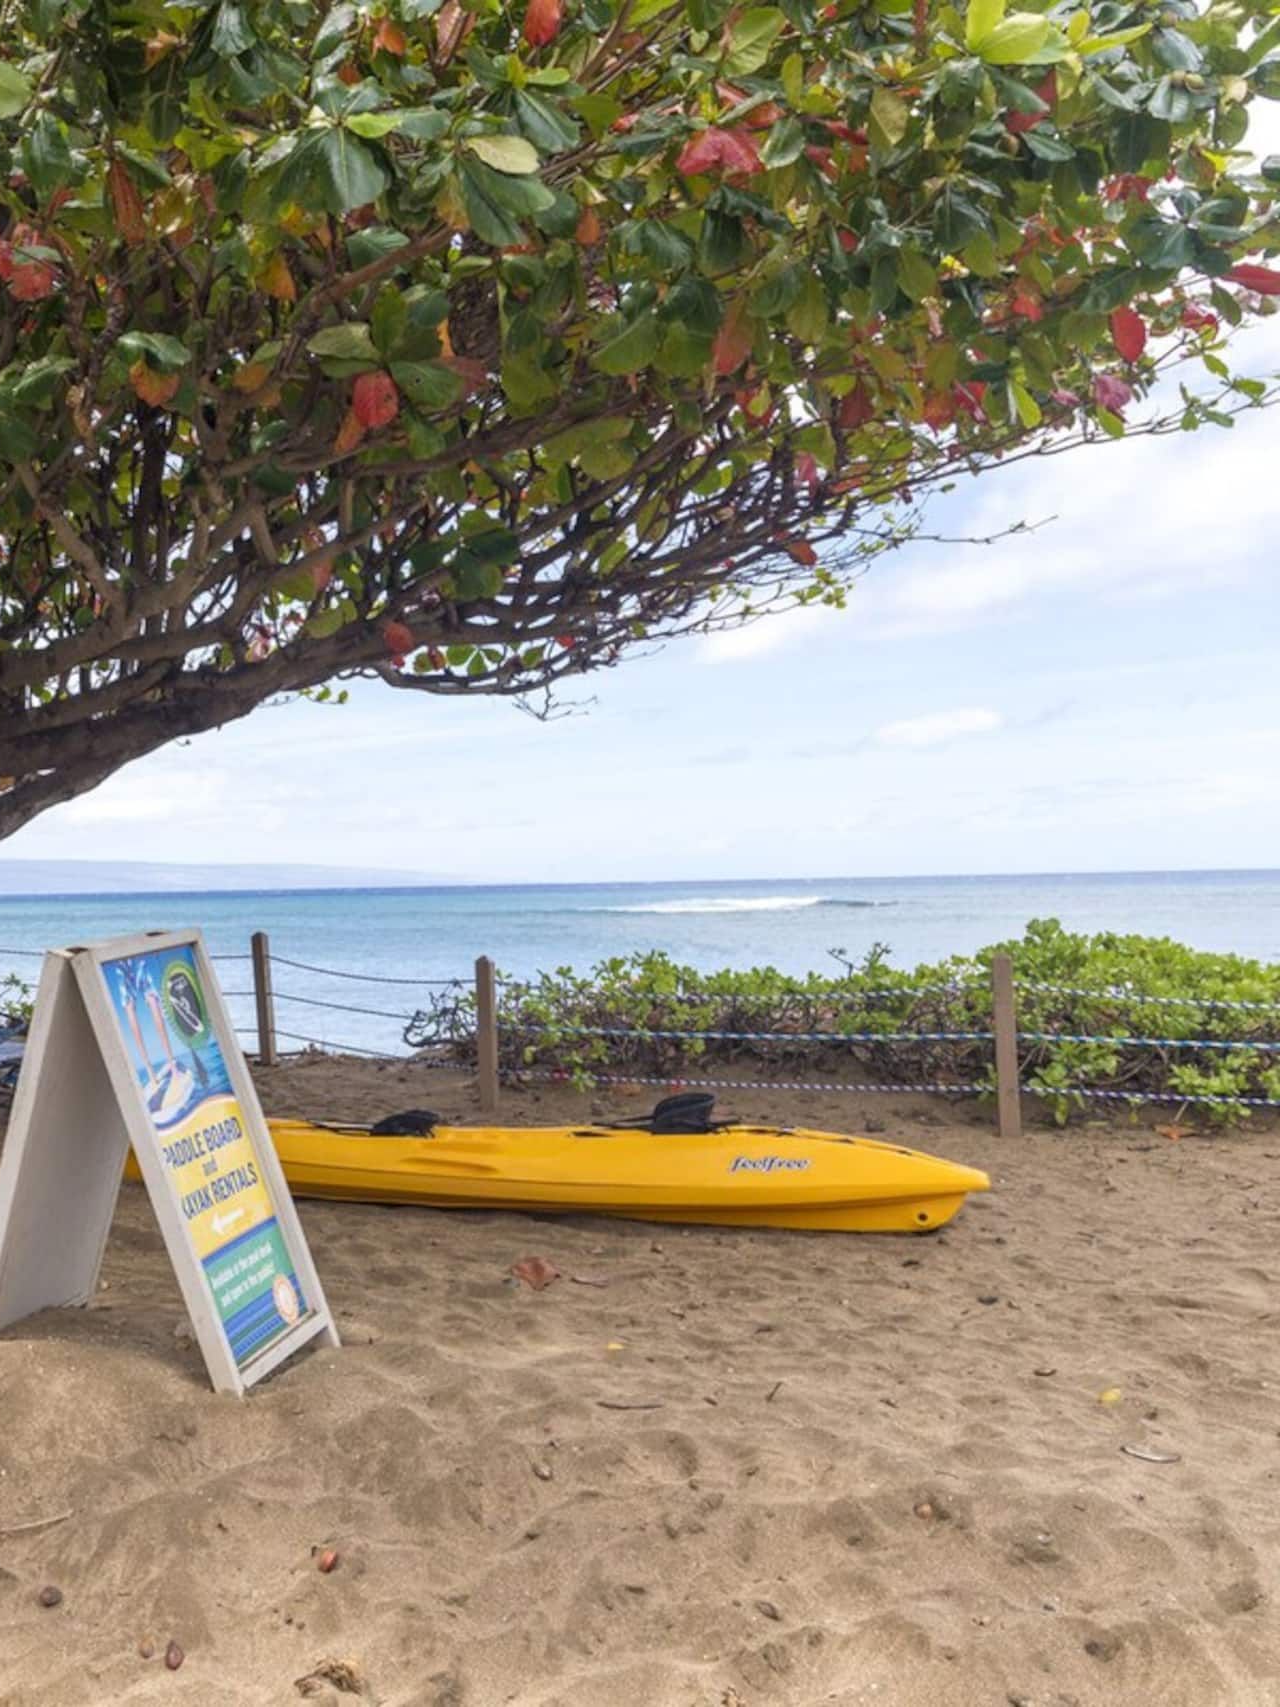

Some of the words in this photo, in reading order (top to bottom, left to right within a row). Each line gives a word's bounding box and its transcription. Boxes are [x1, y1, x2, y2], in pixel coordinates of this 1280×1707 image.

[202, 1116, 243, 1151] BOARD
[729, 1155, 809, 1173] feelfree
[211, 1161, 257, 1204] RENTALS
